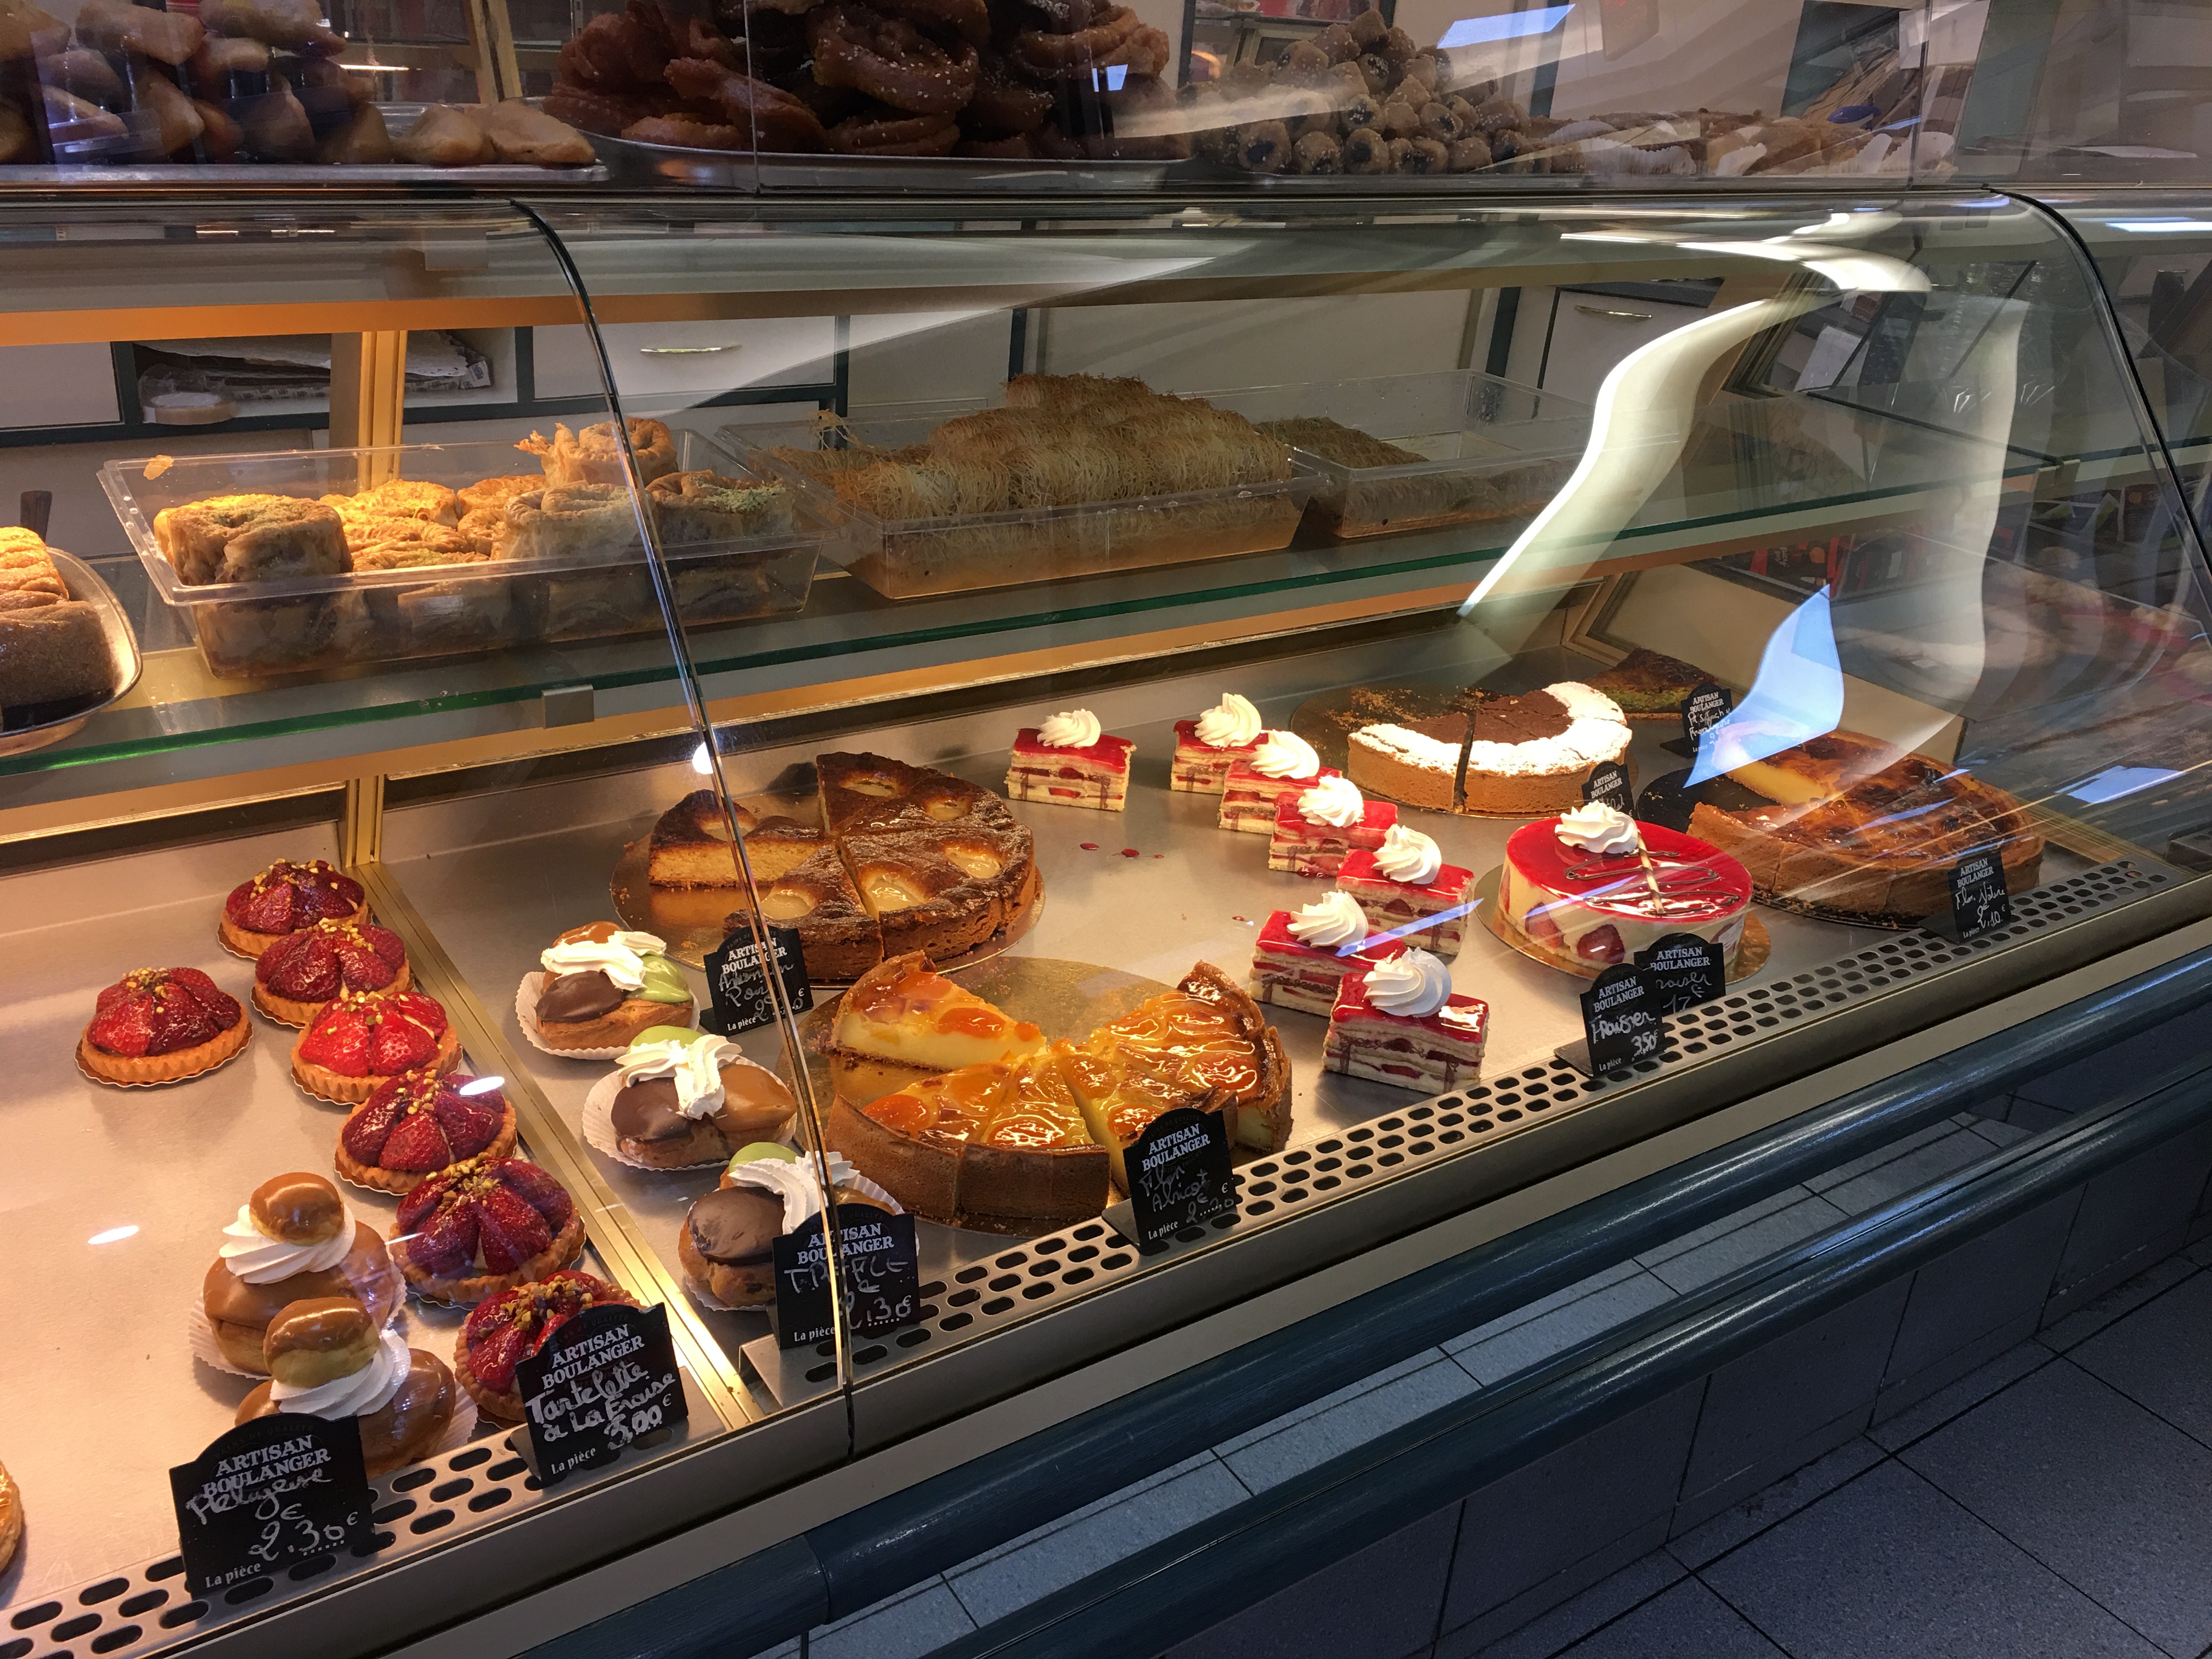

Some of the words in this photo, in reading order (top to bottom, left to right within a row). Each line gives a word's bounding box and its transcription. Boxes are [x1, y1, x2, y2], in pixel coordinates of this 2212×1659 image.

[1690, 698, 1724, 713] BOULANGER
[1693, 692, 1719, 705] ARTISAN
[1590, 777, 1622, 799] BOULANGER
[1594, 770, 1617, 789] ARTISAN
[1957, 866, 1994, 888] BOULANGER
[1960, 858, 1988, 877] ARTISAN
[721, 946, 788, 974] BOULAGER
[1650, 956, 1711, 971] BOULANGER
[1656, 947, 1702, 960] ARTISAN
[1598, 976, 1637, 999] ARTISAN
[1593, 986, 1645, 1013] BOULANGER
[727, 1023, 737, 1031] La
[738, 1015, 757, 1030] pièce
[1607, 1057, 1622, 1070] pièce
[1148, 1124, 1200, 1155] ARTISAN
[1142, 1133, 1210, 1171] BOULANGER
[808, 1223, 881, 1248] AISAN
[1148, 1231, 1158, 1240] La
[1159, 1221, 1178, 1237] pièce
[797, 1236, 895, 1265] BOUANGER
[794, 1331, 806, 1341] La
[809, 1325, 836, 1341] pièce
[552, 1324, 629, 1368] ARTISAN
[541, 1336, 645, 1390] BOULANGER
[216, 1435, 312, 1477] ARTISAN
[551, 1463, 565, 1475] La
[567, 1447, 596, 1470] pièce
[202, 1448, 331, 1498] BOULANGER
[205, 1574, 222, 1588] La
[226, 1562, 262, 1584] pièce
